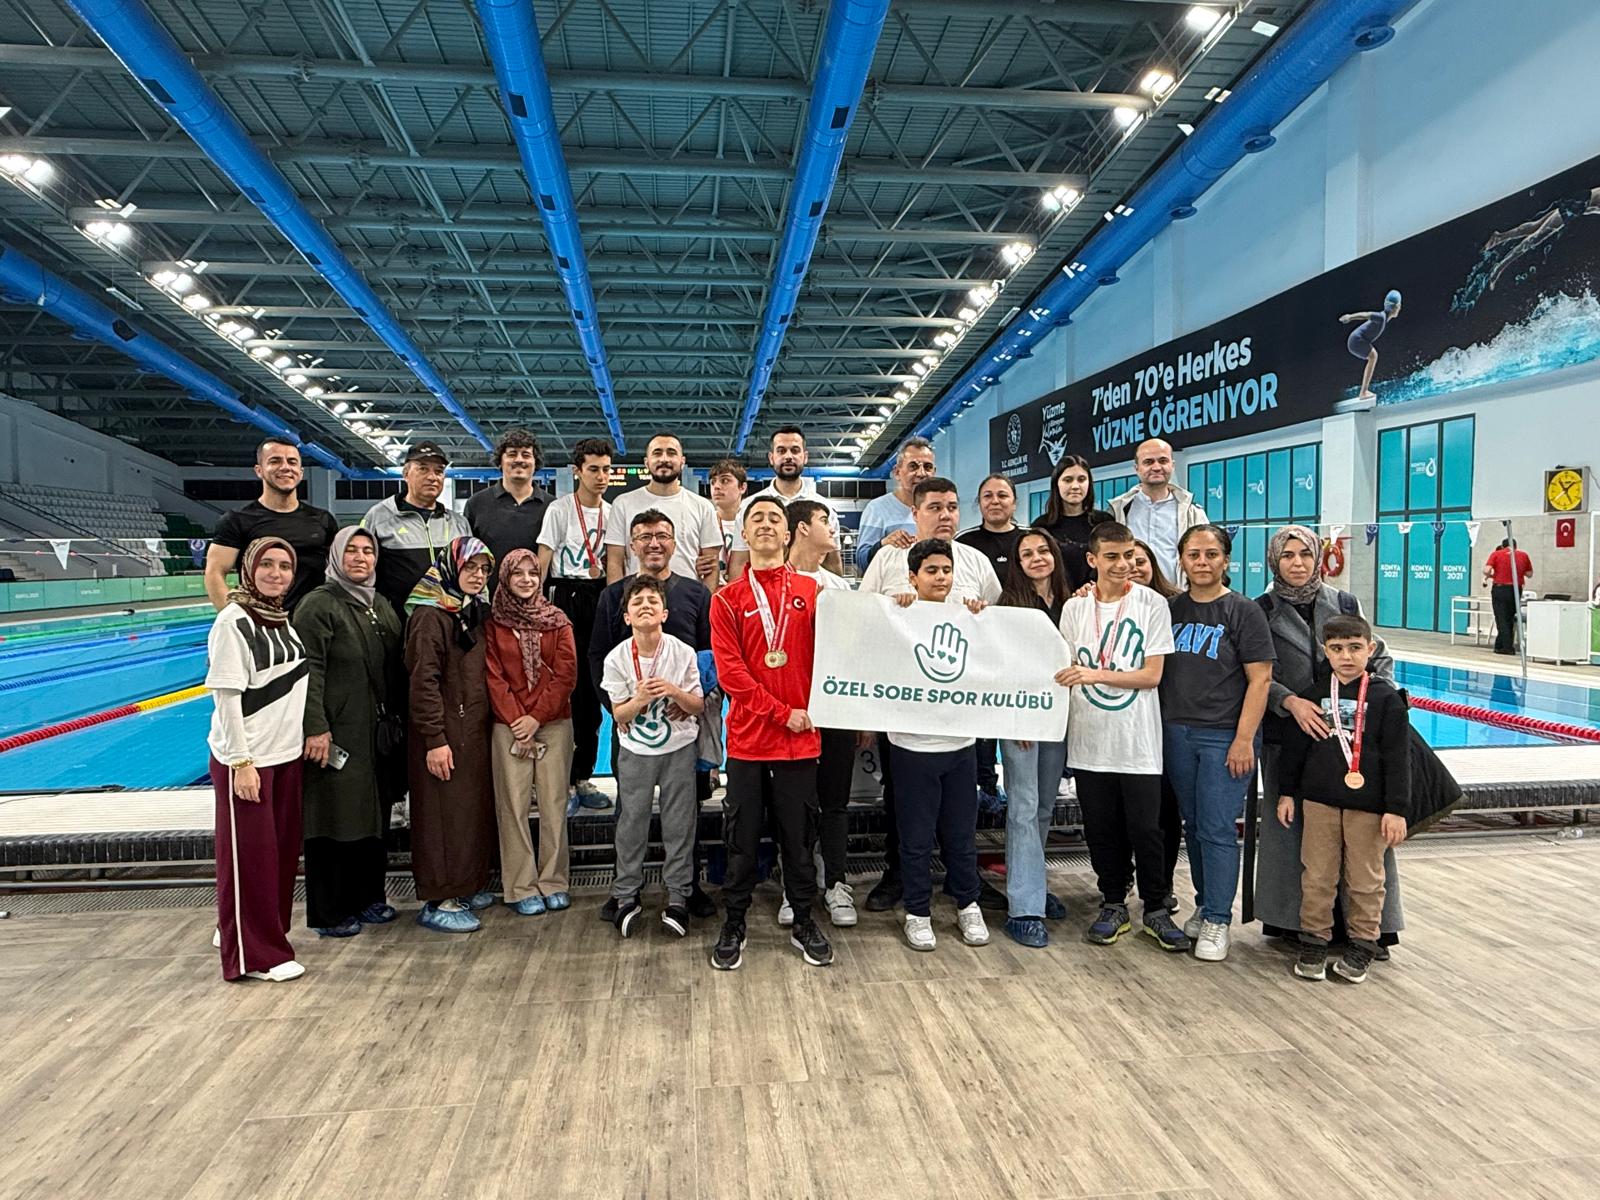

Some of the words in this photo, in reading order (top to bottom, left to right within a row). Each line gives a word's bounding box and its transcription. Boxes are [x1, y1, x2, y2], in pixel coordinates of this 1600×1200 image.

[1092, 382, 1131, 416] 7'den
[1134, 362, 1175, 401] 70'e
[1177, 336, 1252, 387] Herkes
[1092, 411, 1145, 453] YÜZME
[1148, 372, 1278, 438] ÖĞRENİYOR
[1410, 564, 1433, 572] KONYA
[1414, 571, 1430, 579] 2021
[1443, 565, 1467, 573] KONYA
[1446, 572, 1463, 580] 2021
[822, 675, 869, 698] ÖZEL
[872, 684, 924, 702] SOBE
[927, 689, 978, 706] SPOR
[981, 690, 1053, 710] KULÜBÜ
[860, 750, 877, 774] 3
